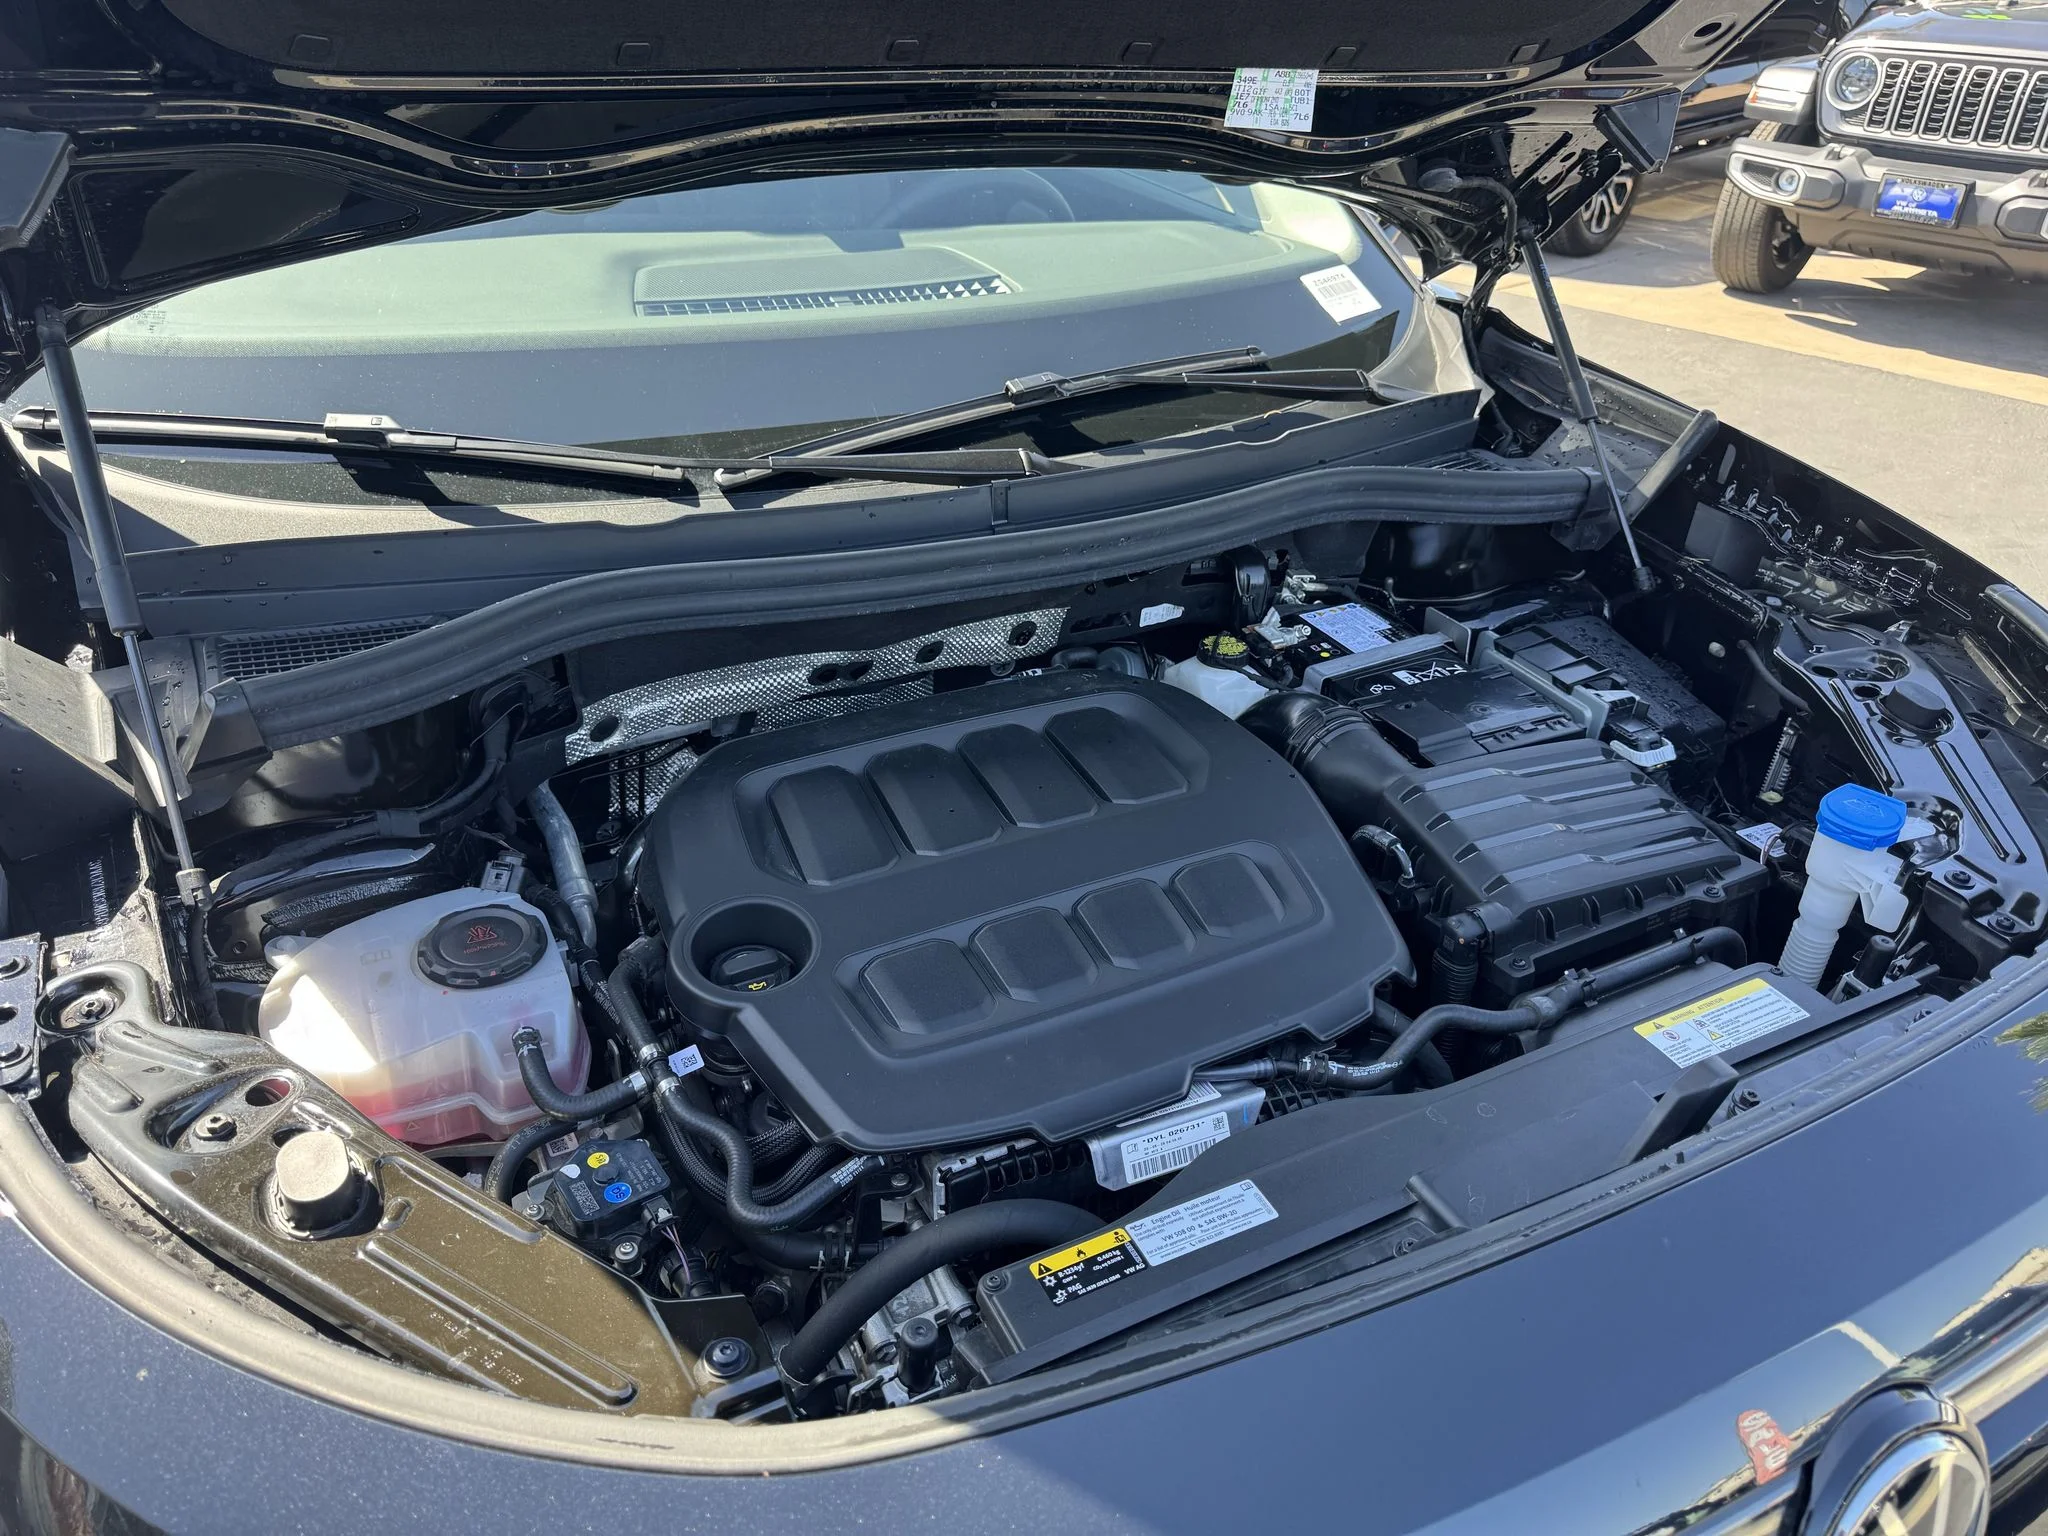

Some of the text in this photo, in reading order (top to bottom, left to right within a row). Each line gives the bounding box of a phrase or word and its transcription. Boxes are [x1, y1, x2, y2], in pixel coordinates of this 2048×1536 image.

[1901, 178, 1945, 189] VOLKSWAGEN
[1697, 997, 1725, 1010] ATTENTION
[1184, 1194, 1220, 1211] Huile moteur
[1151, 1213, 1171, 1225] Engine
[1162, 1234, 1173, 1242] VW
[1174, 1229, 1186, 1237] 508
[1205, 1217, 1216, 1225] SAE
[1216, 1209, 1237, 1221] 0W-20
[1124, 1266, 1135, 1274] VW
[1067, 1282, 1082, 1292] PAG
